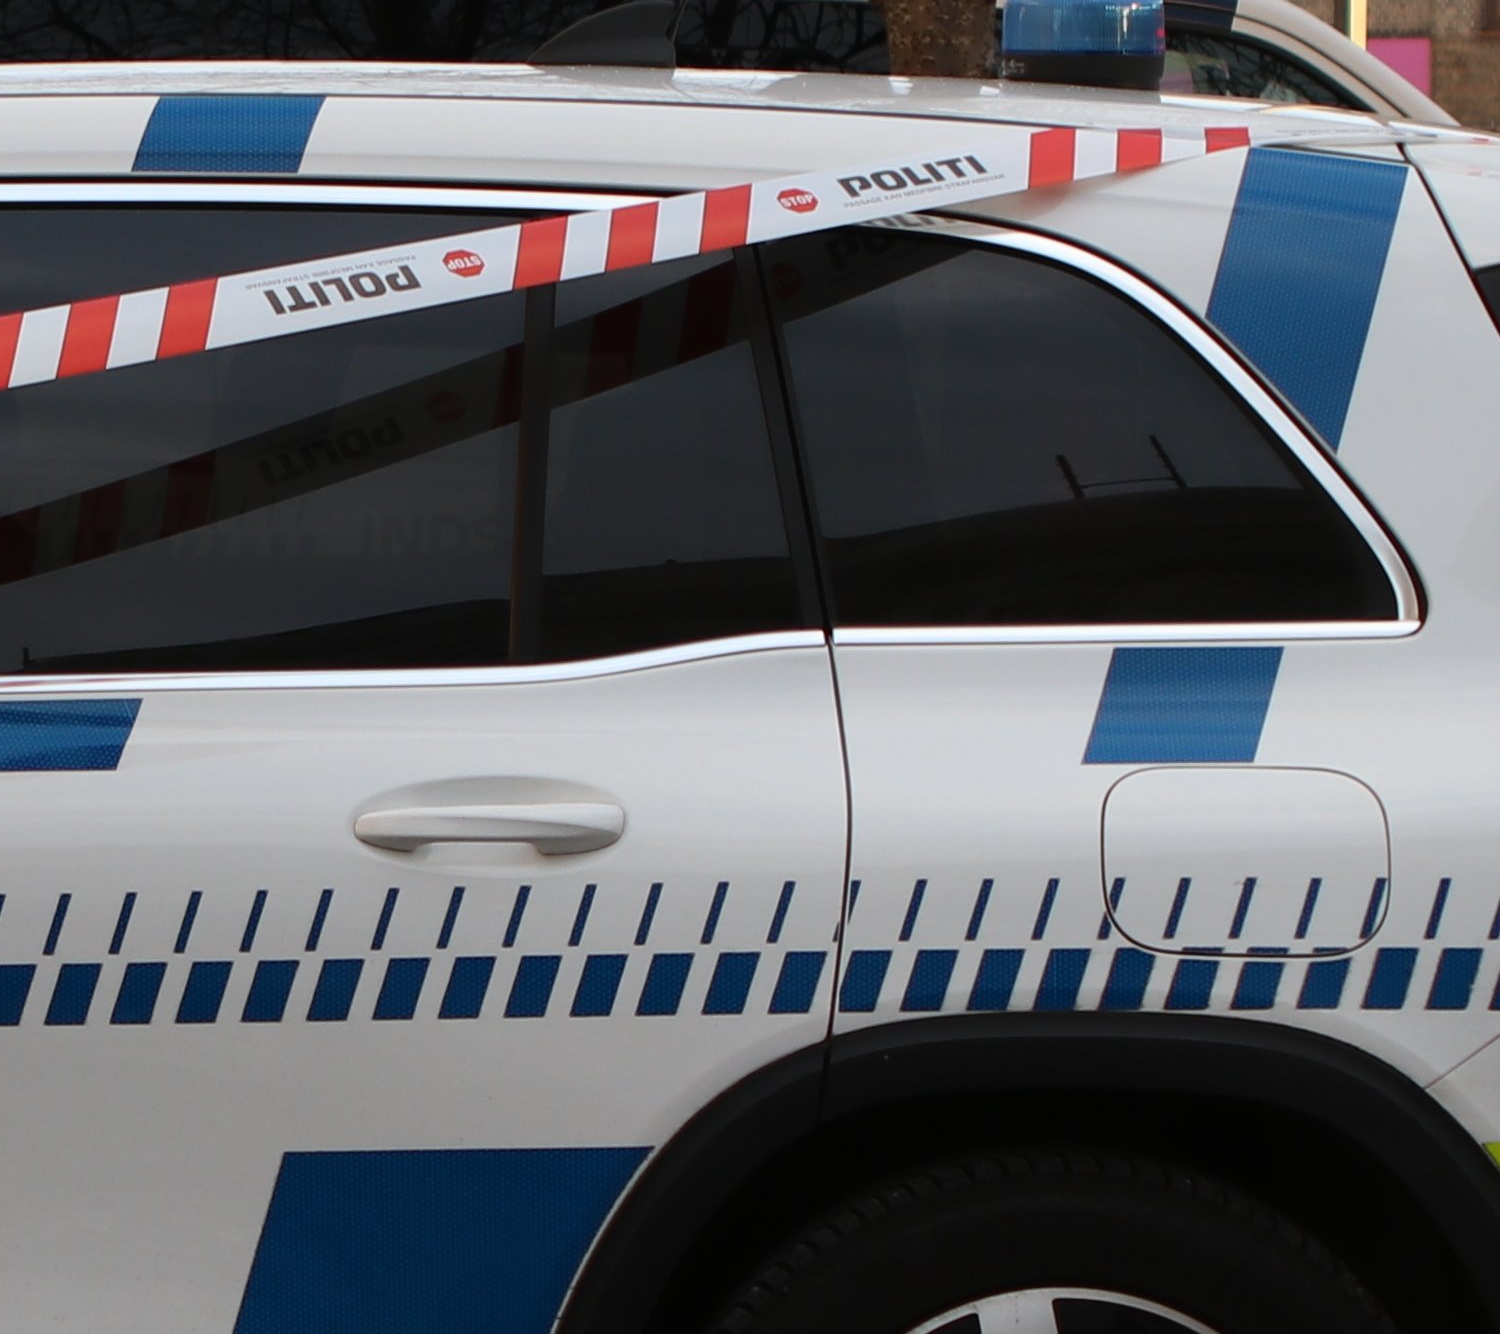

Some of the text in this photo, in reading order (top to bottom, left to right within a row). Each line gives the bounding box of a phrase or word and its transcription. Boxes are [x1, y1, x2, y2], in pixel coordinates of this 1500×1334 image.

[836, 155, 988, 198] POLITI
[780, 193, 814, 208] STOP
[263, 264, 422, 315] POLITI
